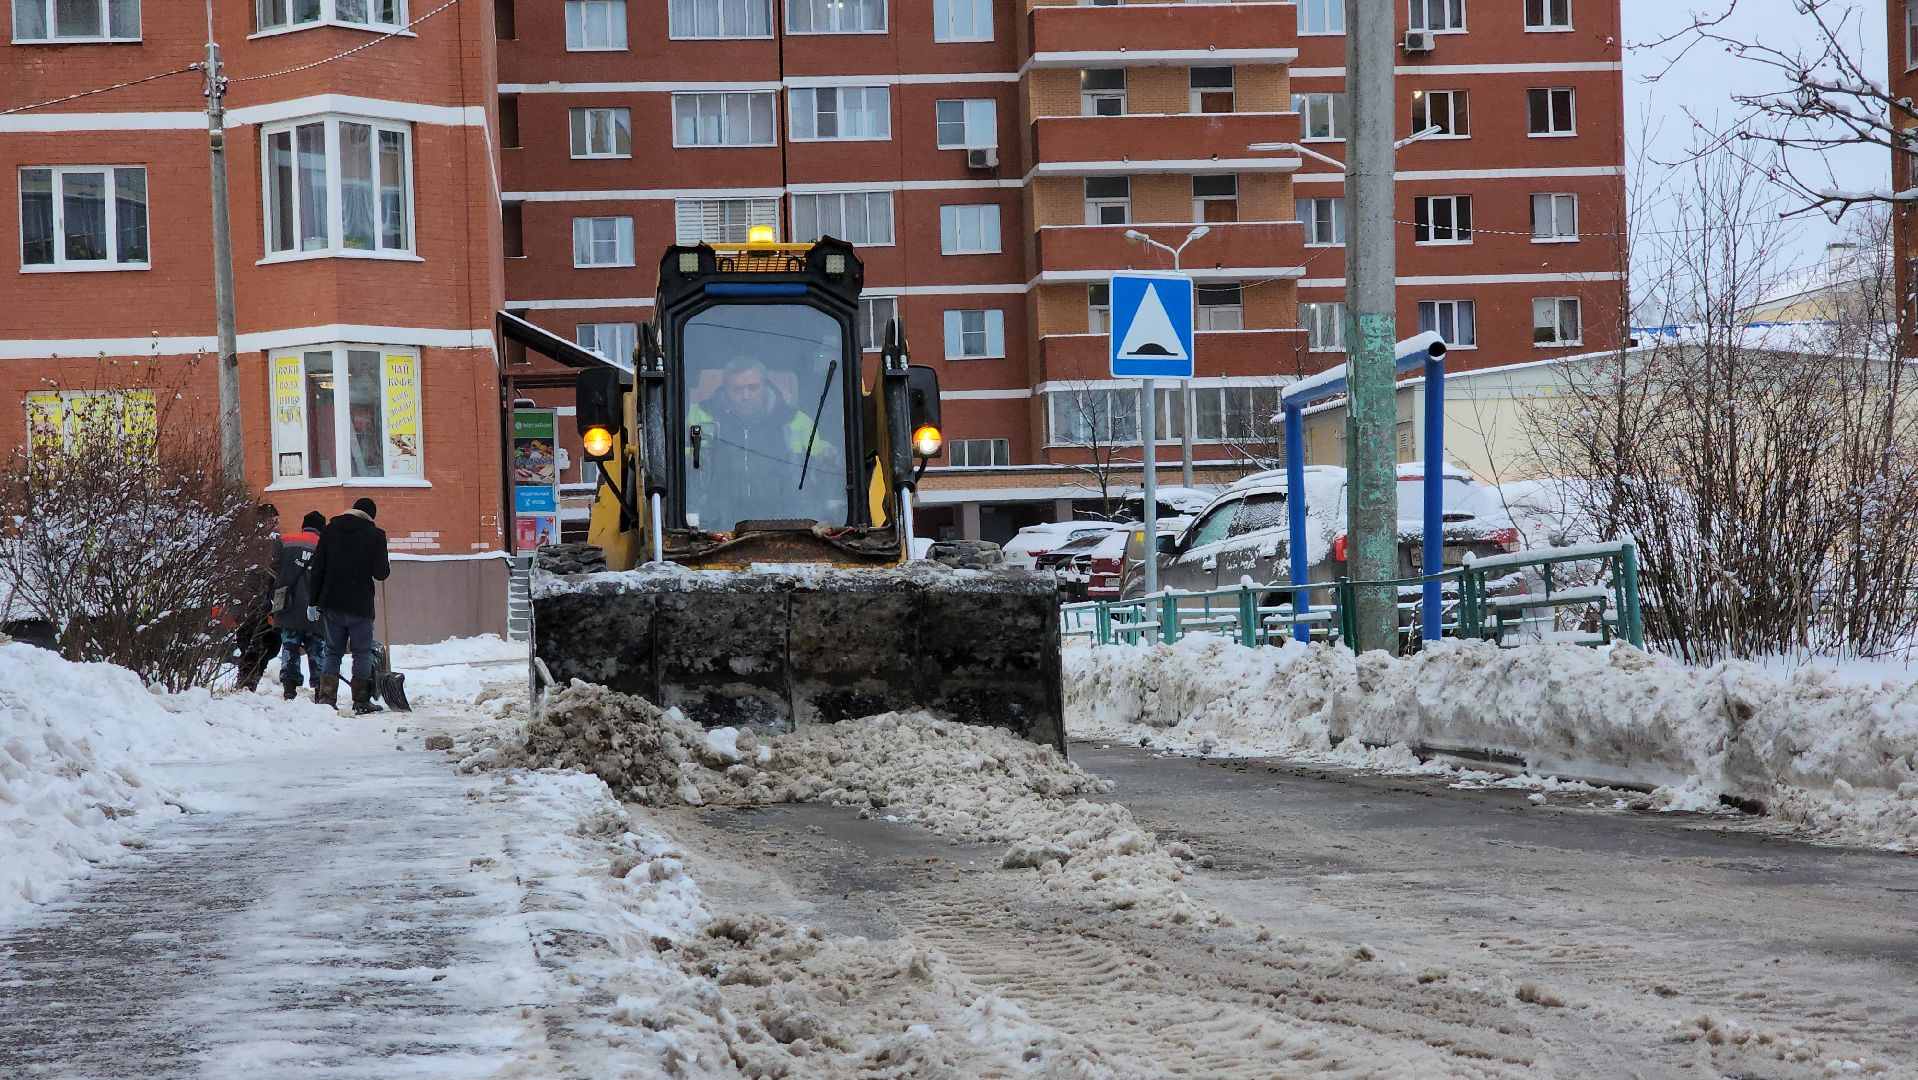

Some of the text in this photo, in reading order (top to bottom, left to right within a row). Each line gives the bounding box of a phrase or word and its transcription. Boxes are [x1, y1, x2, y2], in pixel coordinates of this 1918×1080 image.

[391, 363, 409, 375] ЧАЙ
[388, 377, 413, 387] КОФЕ
[279, 395, 300, 406] ПИВО
